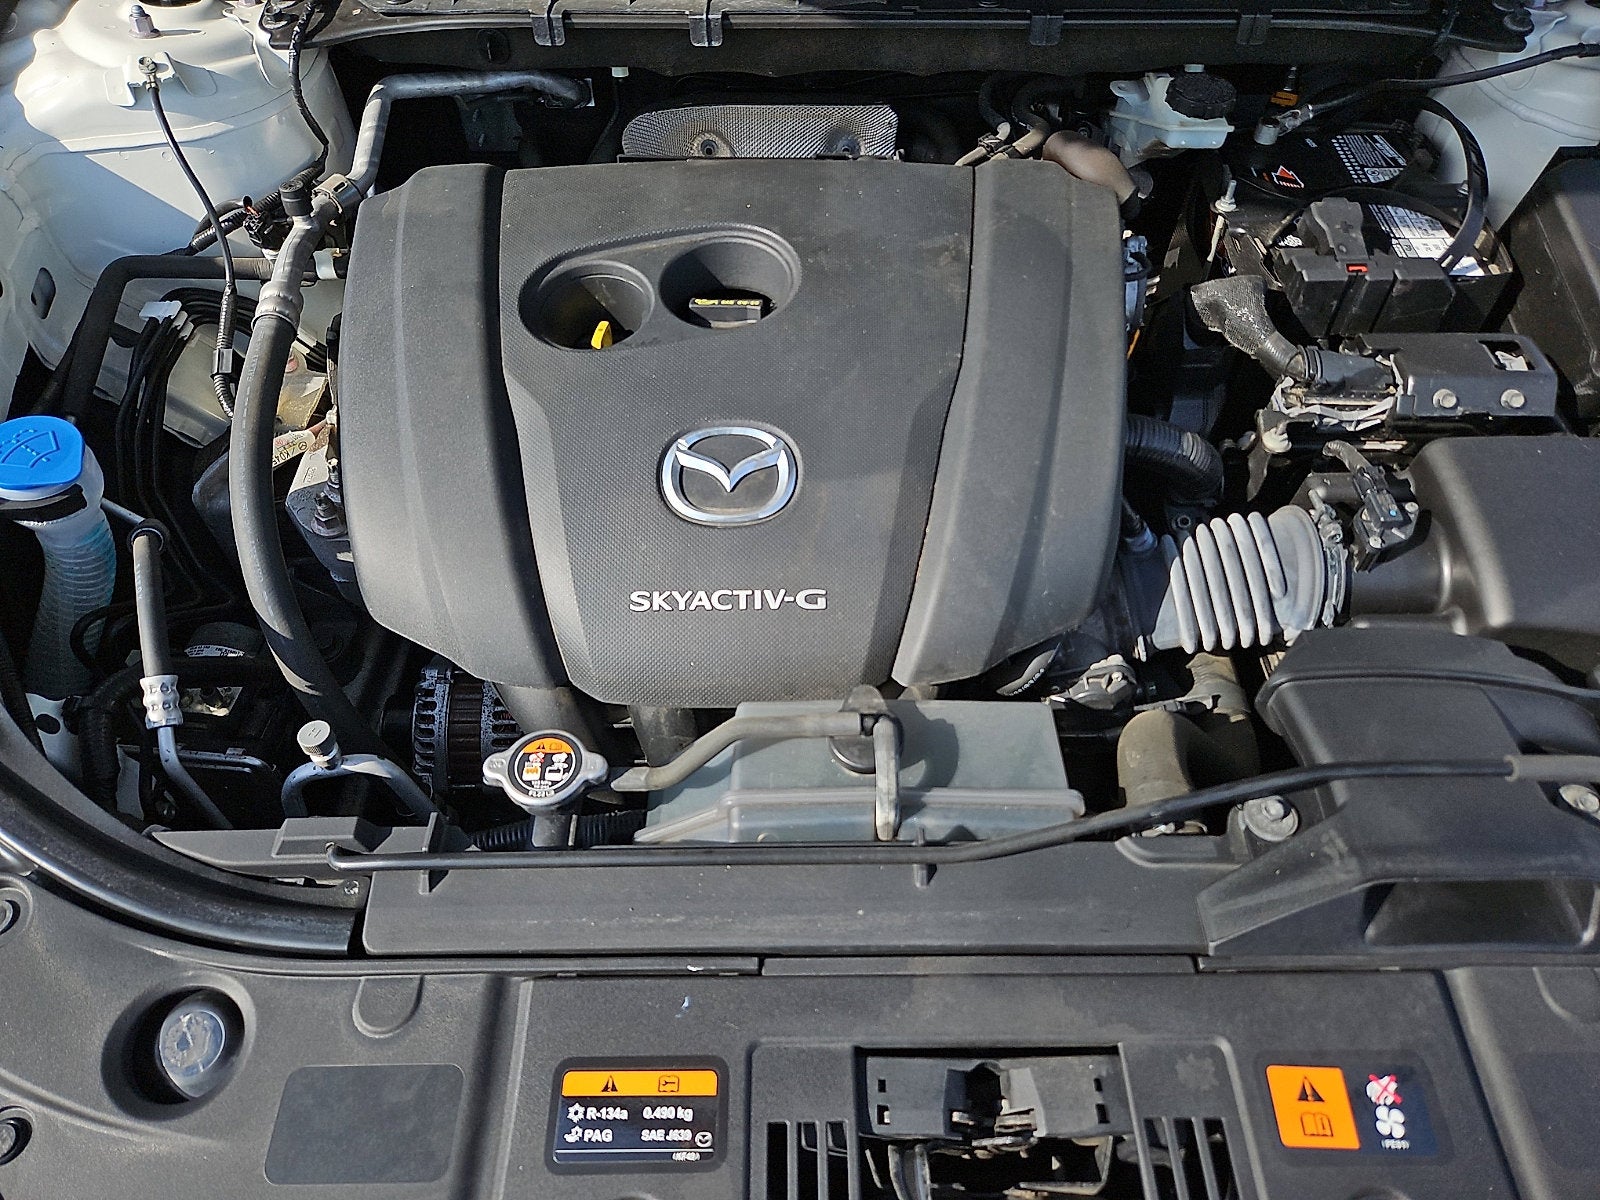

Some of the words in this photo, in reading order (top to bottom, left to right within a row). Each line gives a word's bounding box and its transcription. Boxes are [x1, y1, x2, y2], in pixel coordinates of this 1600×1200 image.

[629, 588, 827, 612] SKYACTIV-G
[586, 1106, 629, 1121] R-134a
[677, 1106, 694, 1122] kg
[583, 1129, 613, 1143] PAG
[641, 1129, 665, 1142] SAE
